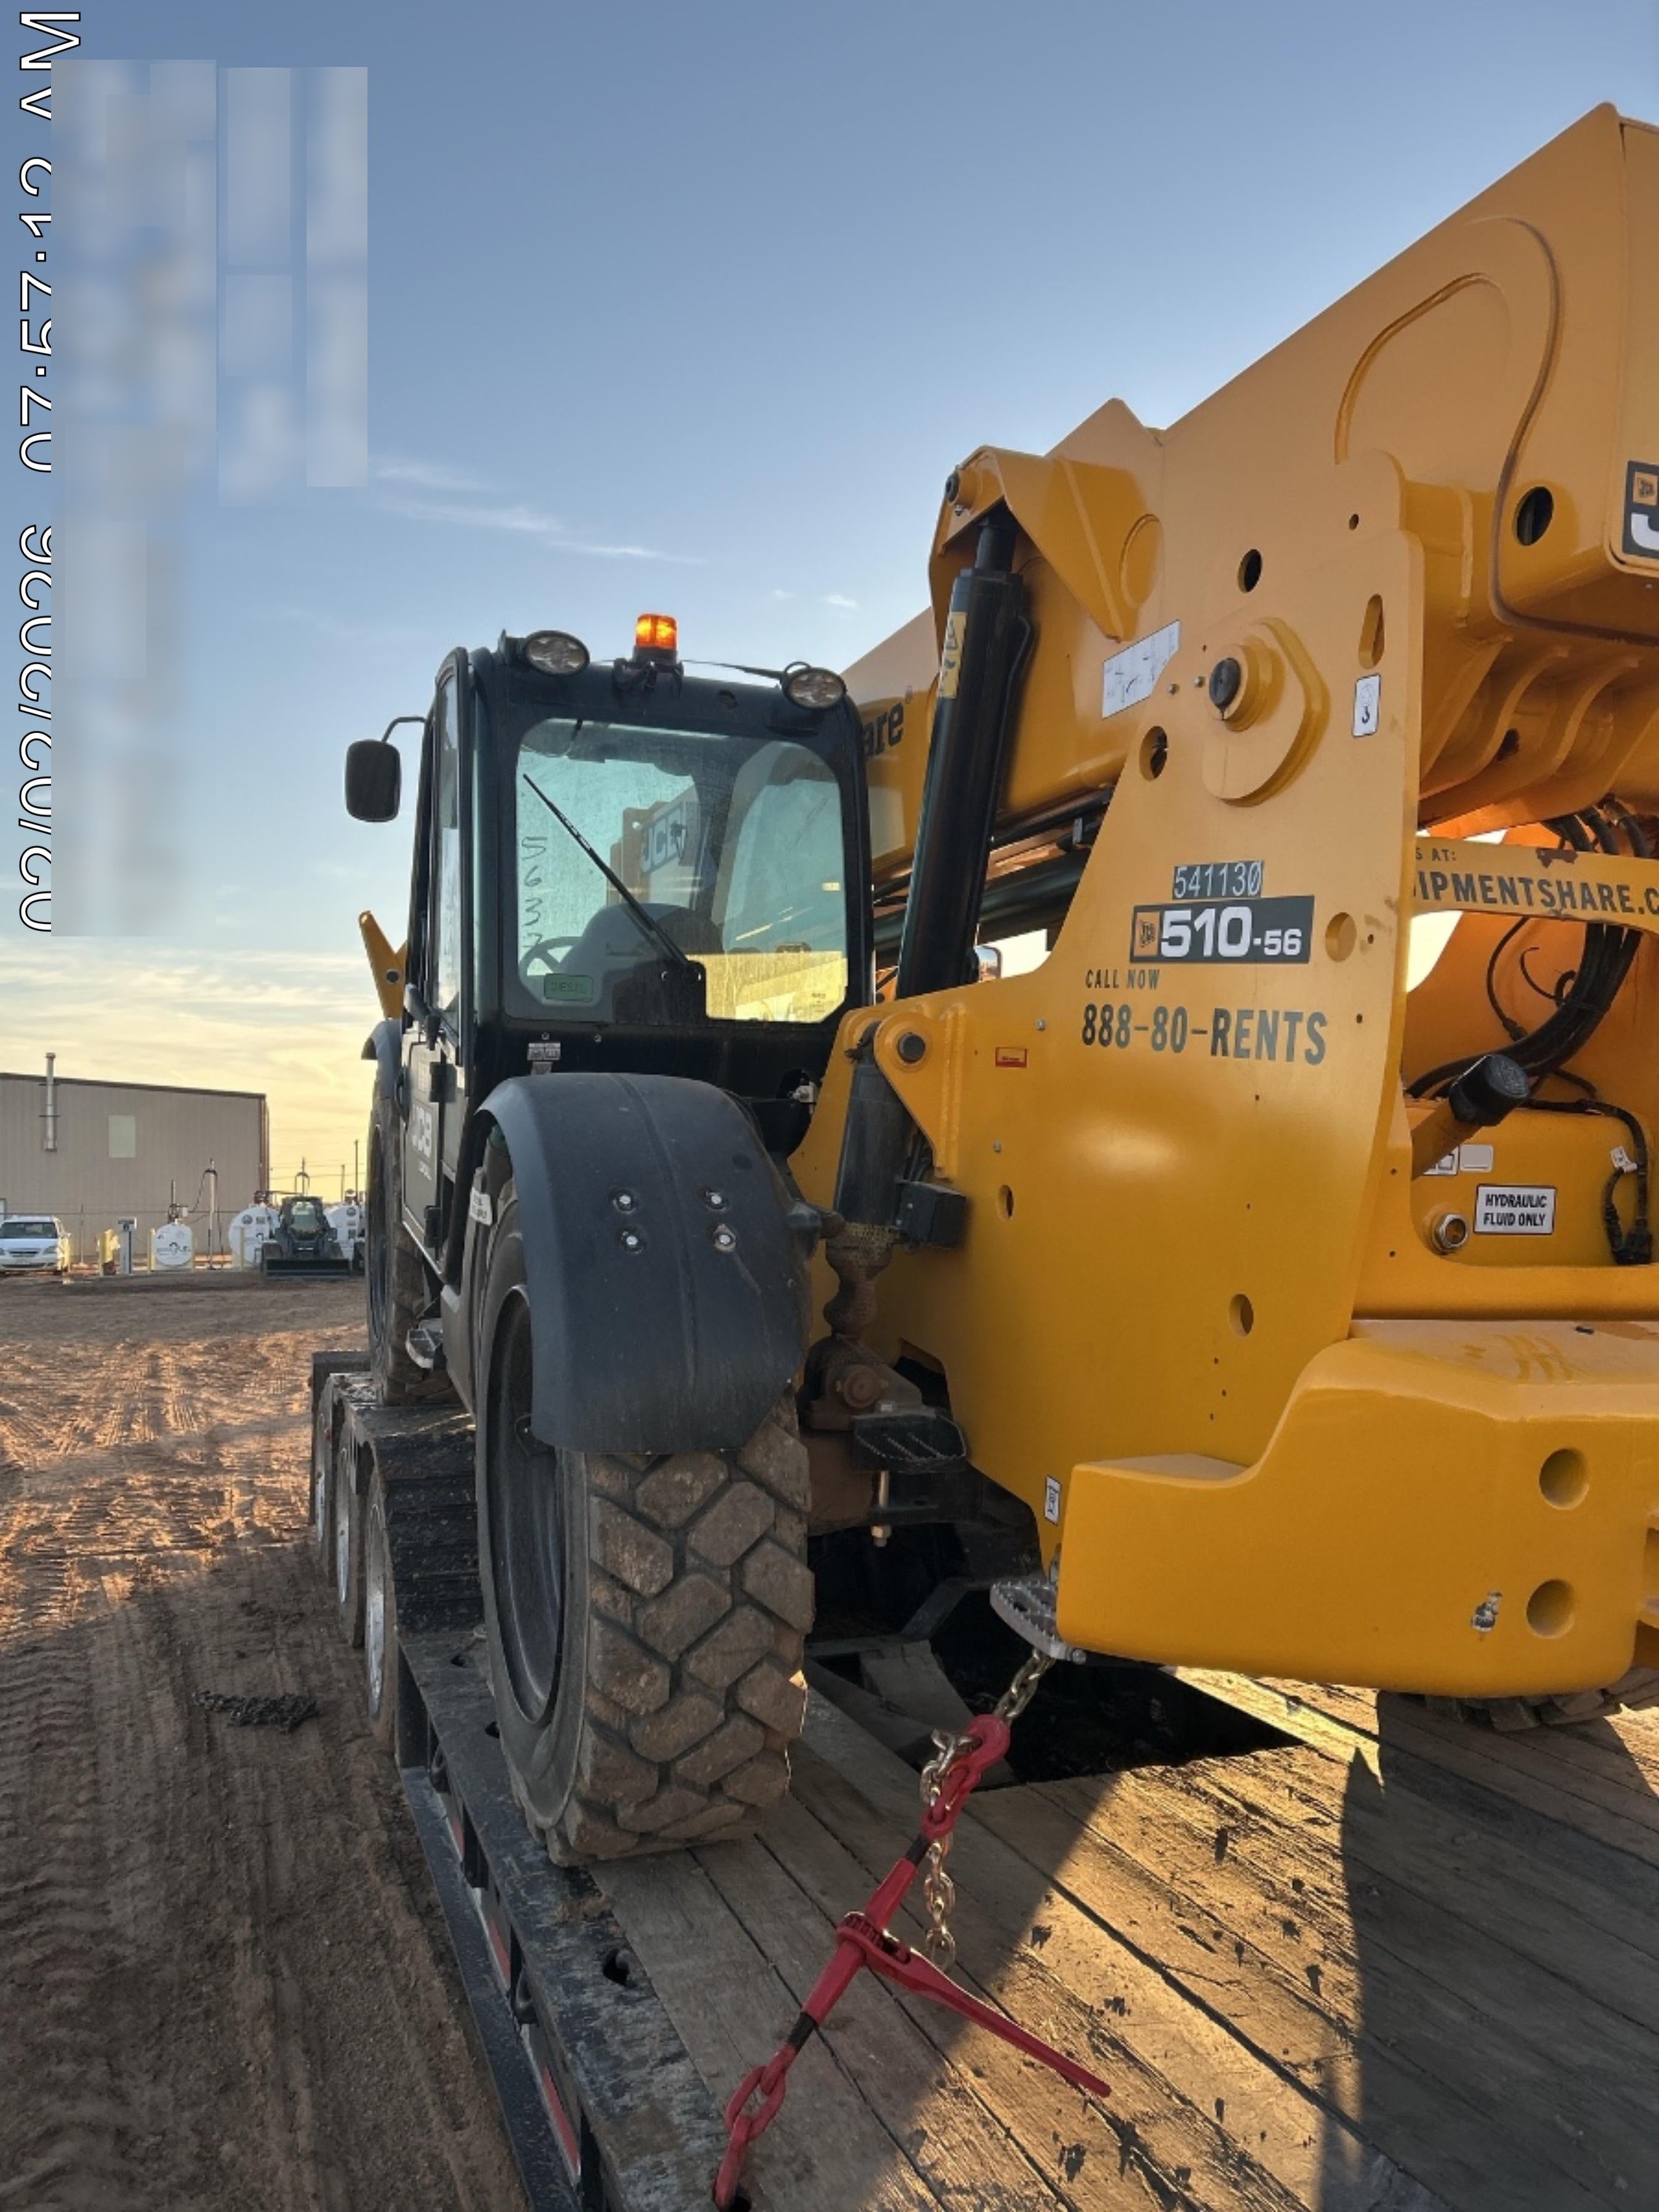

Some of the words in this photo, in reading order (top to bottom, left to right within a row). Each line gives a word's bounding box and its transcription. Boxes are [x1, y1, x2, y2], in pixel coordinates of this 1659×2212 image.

[1432, 848, 1457, 861] AT:
[1174, 860, 1261, 898] 541130
[1414, 871, 1659, 915] IPMENTSHARE.C
[1085, 969, 1120, 989] CALL
[1126, 970, 1161, 990] NOW
[1081, 1003, 1328, 1065] 888-80-RENTS
[1485, 1194, 1547, 1209] HYDRAULIC
[1483, 1212, 1515, 1226] FLUID
[1518, 1213, 1546, 1227] ONLY
